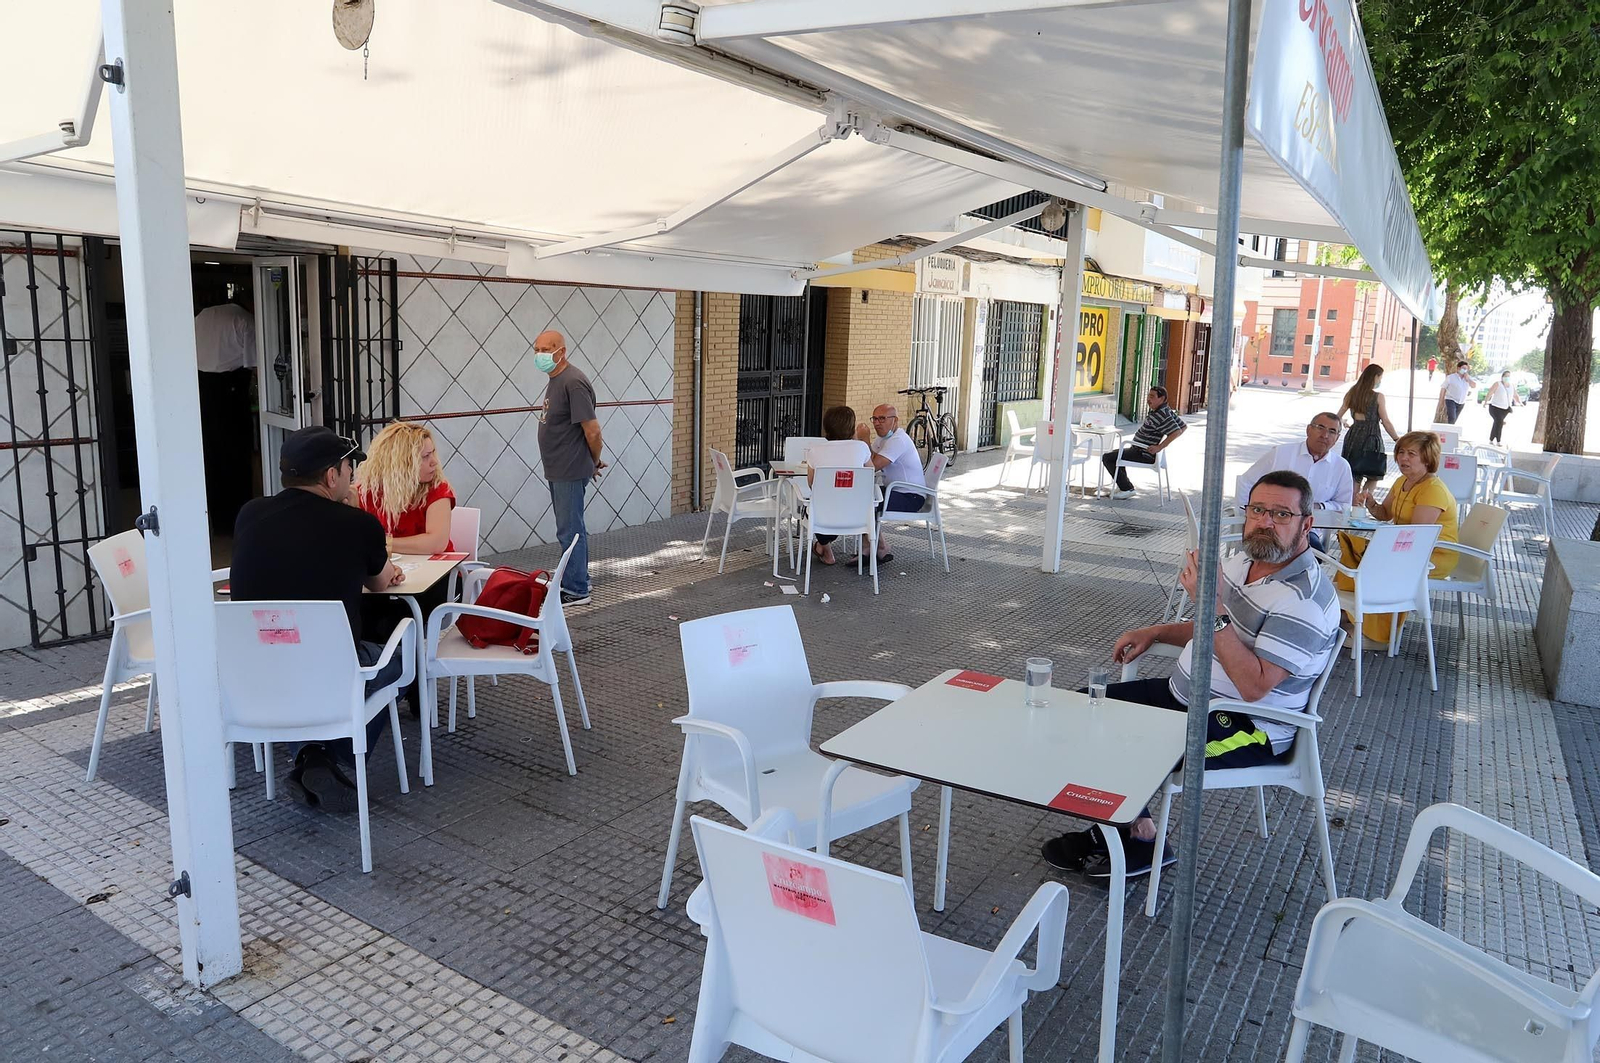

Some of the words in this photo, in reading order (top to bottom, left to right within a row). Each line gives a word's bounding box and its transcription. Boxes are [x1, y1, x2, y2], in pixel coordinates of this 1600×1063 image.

[1081, 273, 1106, 297] MPRO
[1079, 311, 1104, 337] PRO
[1074, 341, 1102, 387] RO
[1066, 790, 1114, 806] Cruzcampo
[773, 874, 823, 897] Cruzcampo
